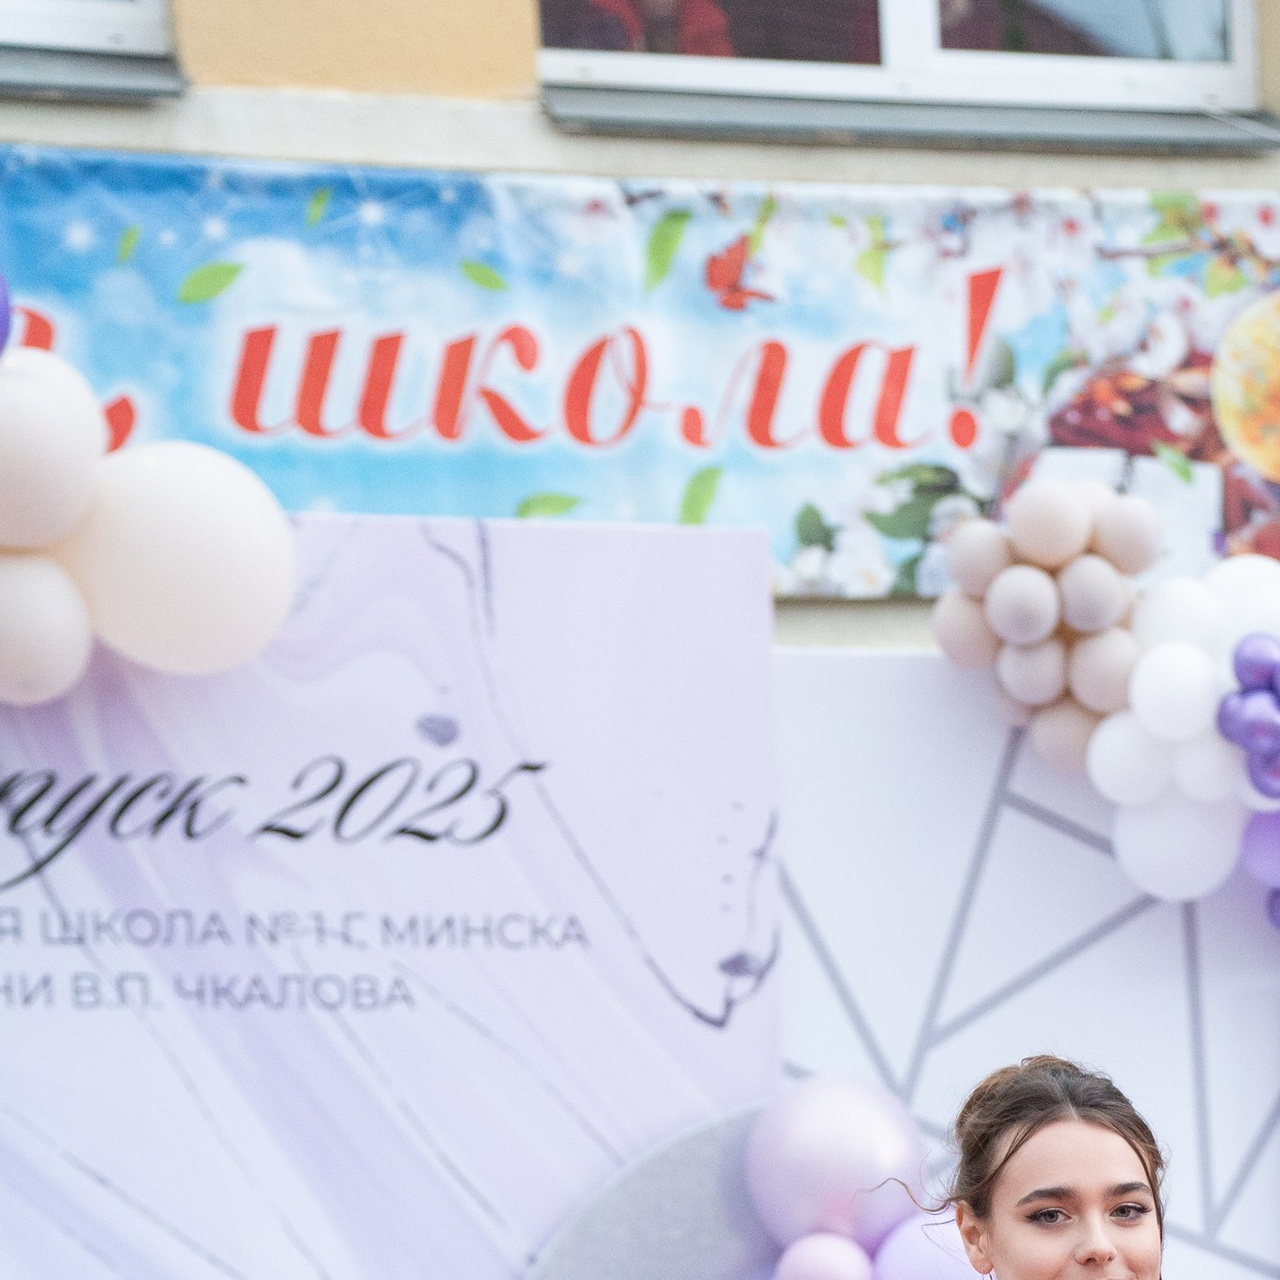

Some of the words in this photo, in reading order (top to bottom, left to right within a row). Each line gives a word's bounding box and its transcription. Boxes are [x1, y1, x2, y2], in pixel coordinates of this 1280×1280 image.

[228, 267, 1003, 449] школа!
[249, 754, 549, 845] 2025
[39, 907, 234, 948] ШКОЛА
[380, 911, 593, 950] МИНСКА
[172, 972, 417, 1013] ЧКАЛОВА
